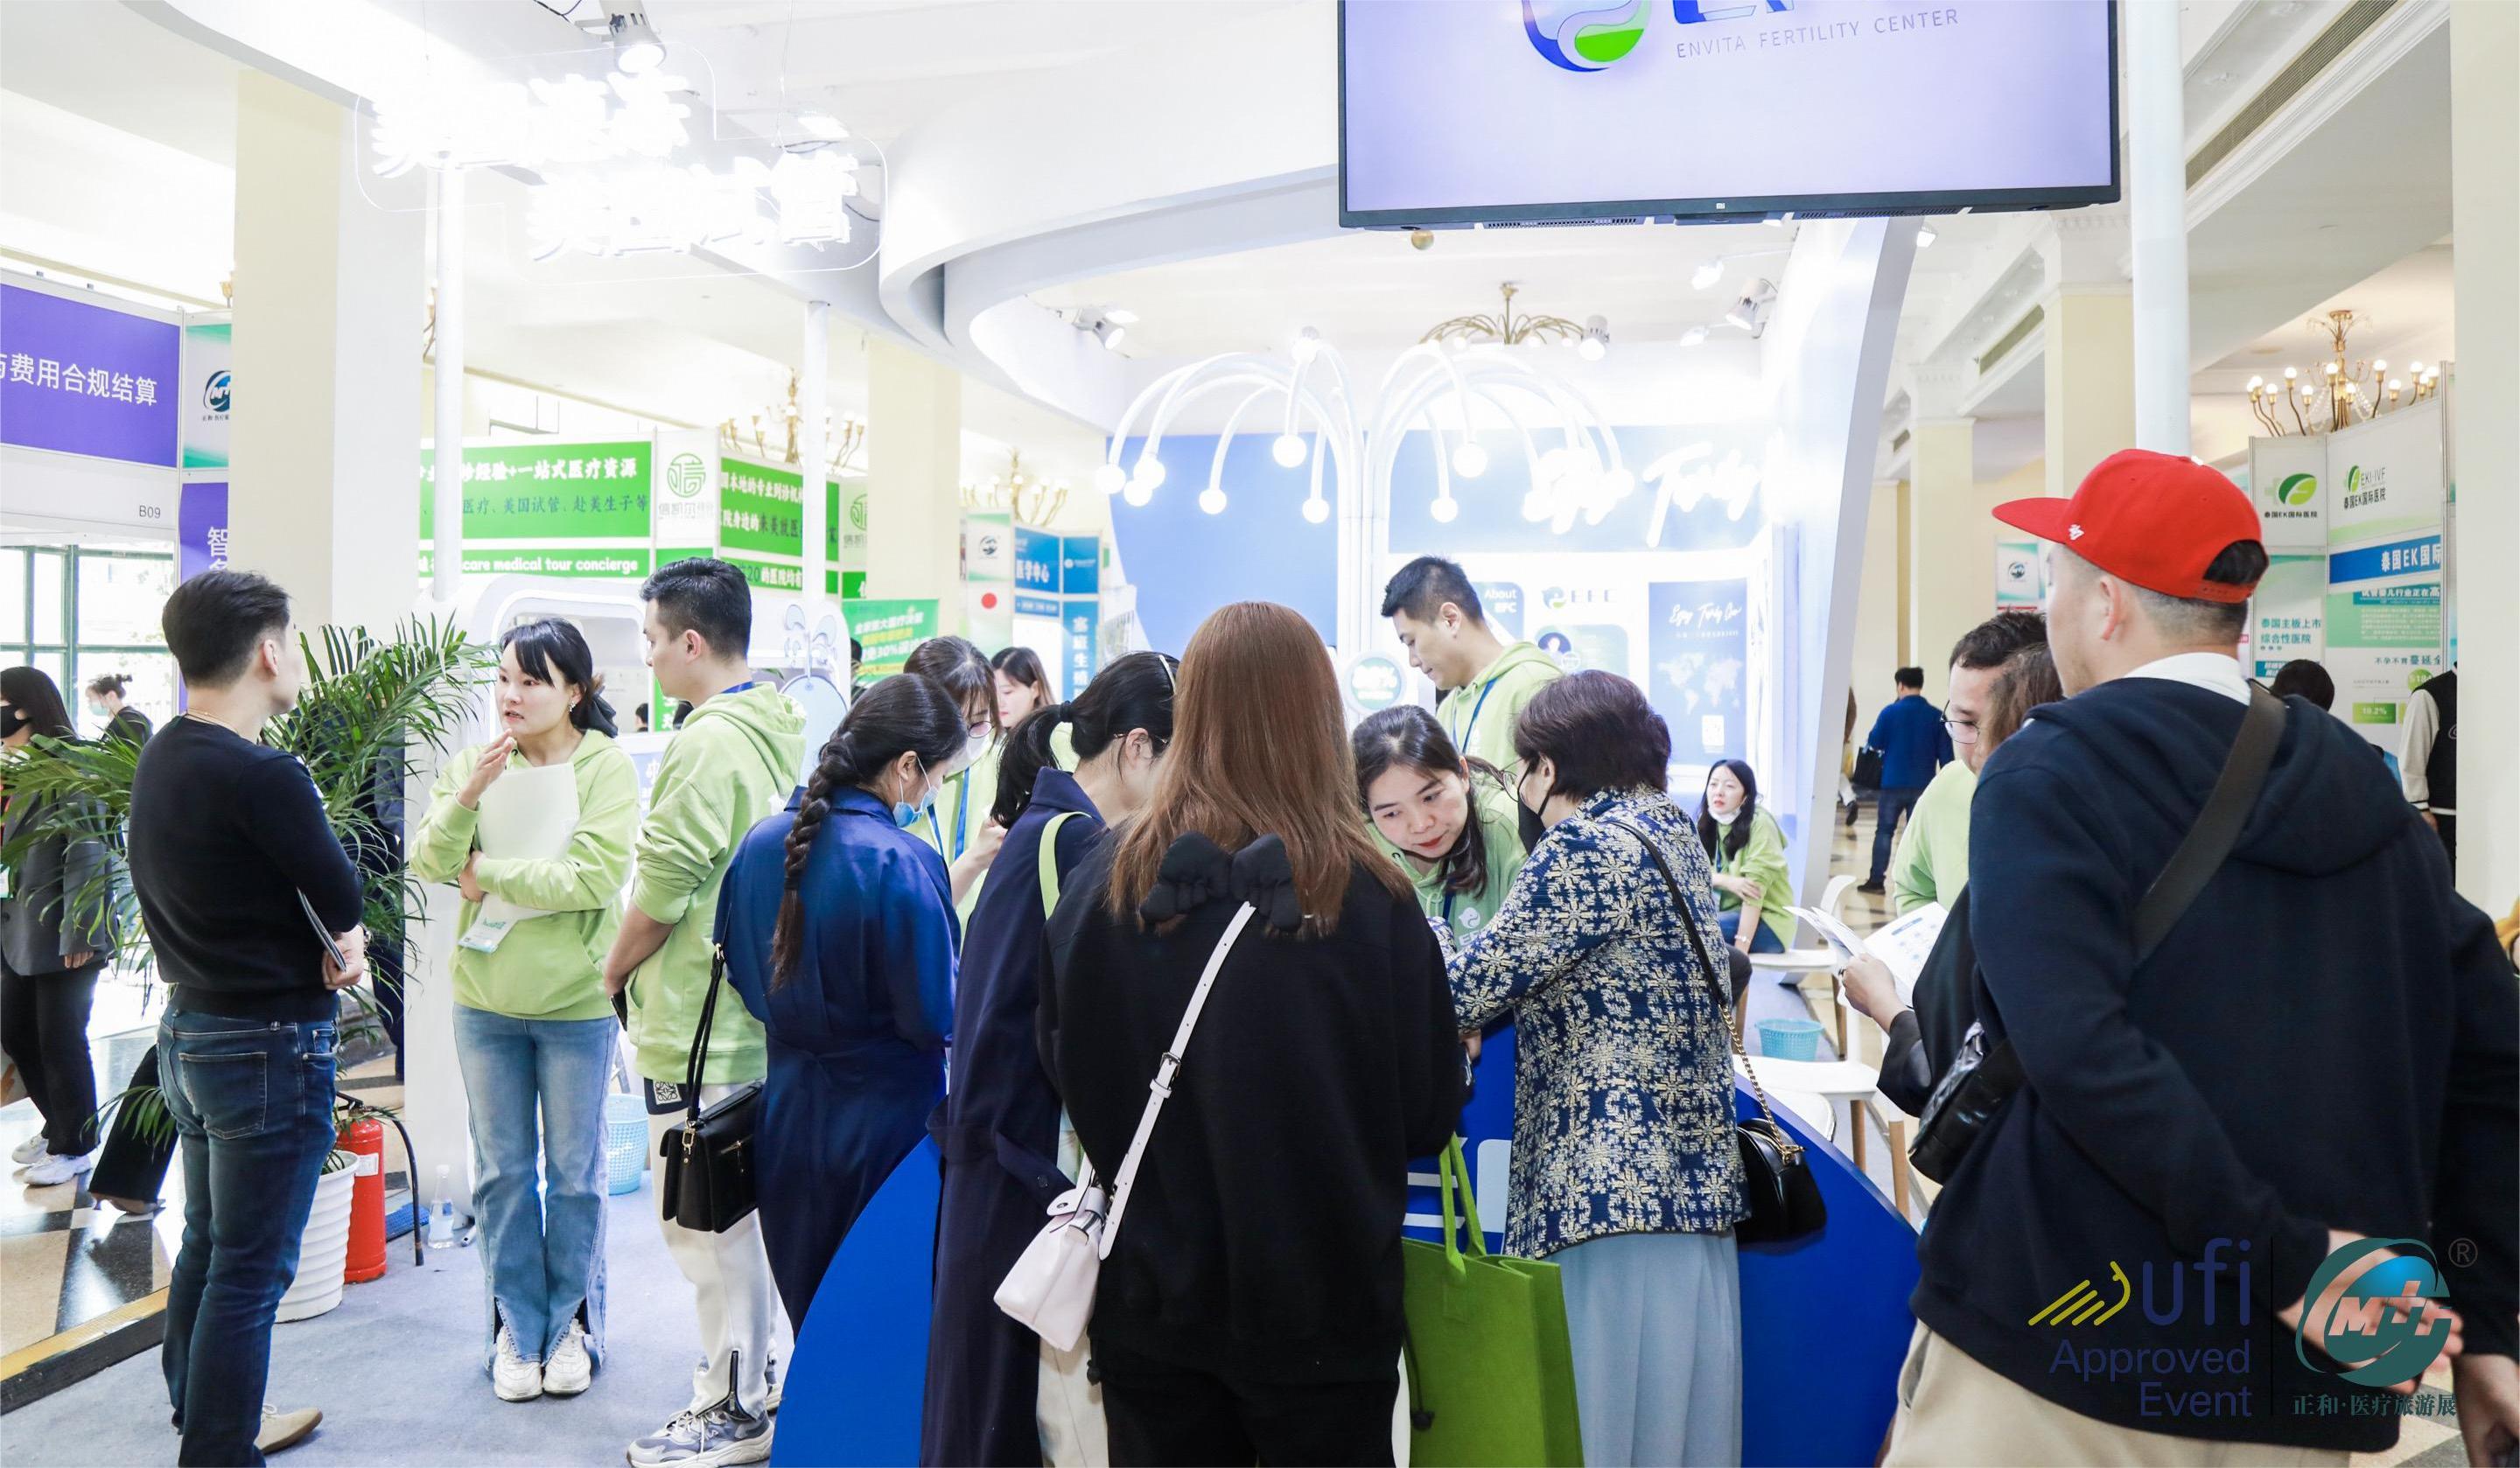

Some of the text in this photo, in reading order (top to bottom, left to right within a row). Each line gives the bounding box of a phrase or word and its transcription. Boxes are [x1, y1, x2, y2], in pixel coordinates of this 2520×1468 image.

[1676, 9, 1959, 58] ENVITA FERTILITY CENTER
[2343, 487, 2386, 510] 泰国EK国际医院
[139, 505, 161, 519] B09
[494, 556, 542, 571] medical
[545, 557, 573, 571] tour
[576, 556, 638, 574] concierge
[2261, 618, 2321, 629] 泰国主板上市
[2261, 633, 2312, 644] 综合性医院
[1459, 930, 1485, 945] EF
